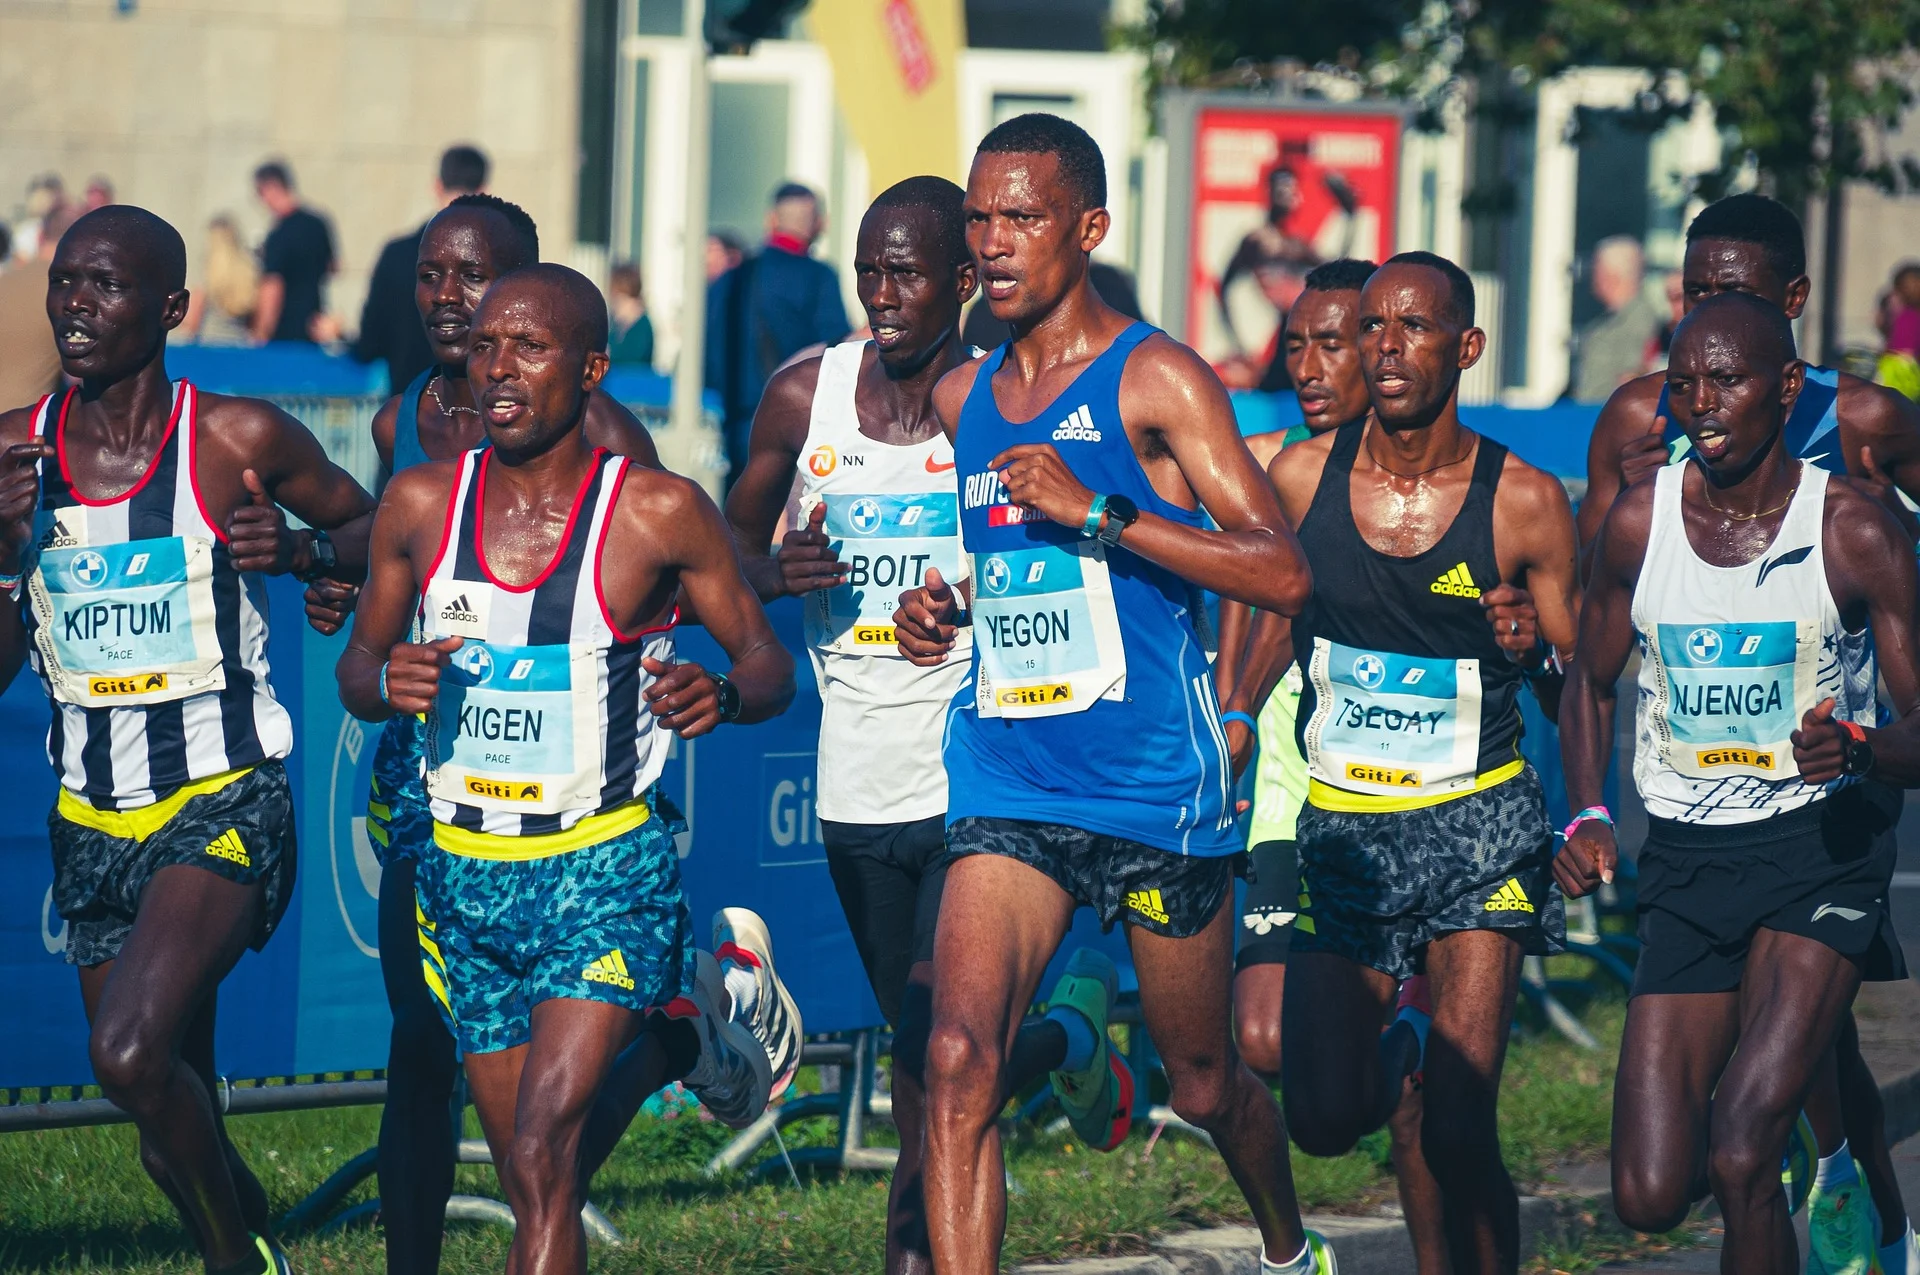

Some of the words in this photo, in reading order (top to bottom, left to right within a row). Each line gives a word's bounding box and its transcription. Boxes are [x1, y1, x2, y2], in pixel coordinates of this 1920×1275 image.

[1052, 427, 1102, 442] adidas
[843, 455, 864, 466] NN
[37, 537, 78, 550] adidas
[850, 554, 931, 587] BOIT
[1430, 581, 1481, 599] adidas
[883, 601, 893, 610] 12
[64, 600, 171, 641] KIPTUM
[441, 610, 478, 623] adidas
[985, 609, 1070, 649] YEGON
[107, 650, 133, 660] PACE
[1025, 660, 1035, 669] 15
[94, 679, 137, 693] Giti
[1002, 690, 1045, 704] Giti
[1673, 680, 1783, 716] NJENGA
[456, 705, 543, 742] KIGEN
[1335, 698, 1446, 735] TSEGAY
[1727, 725, 1738, 734] 10
[1380, 743, 1390, 751] 11
[485, 753, 511, 764] PACE
[1703, 751, 1749, 764] Giti
[1351, 768, 1392, 783] Giti
[470, 781, 511, 798] Giti
[205, 845, 250, 867] adidas
[1484, 899, 1535, 913] adidas
[582, 968, 635, 991] adidas
